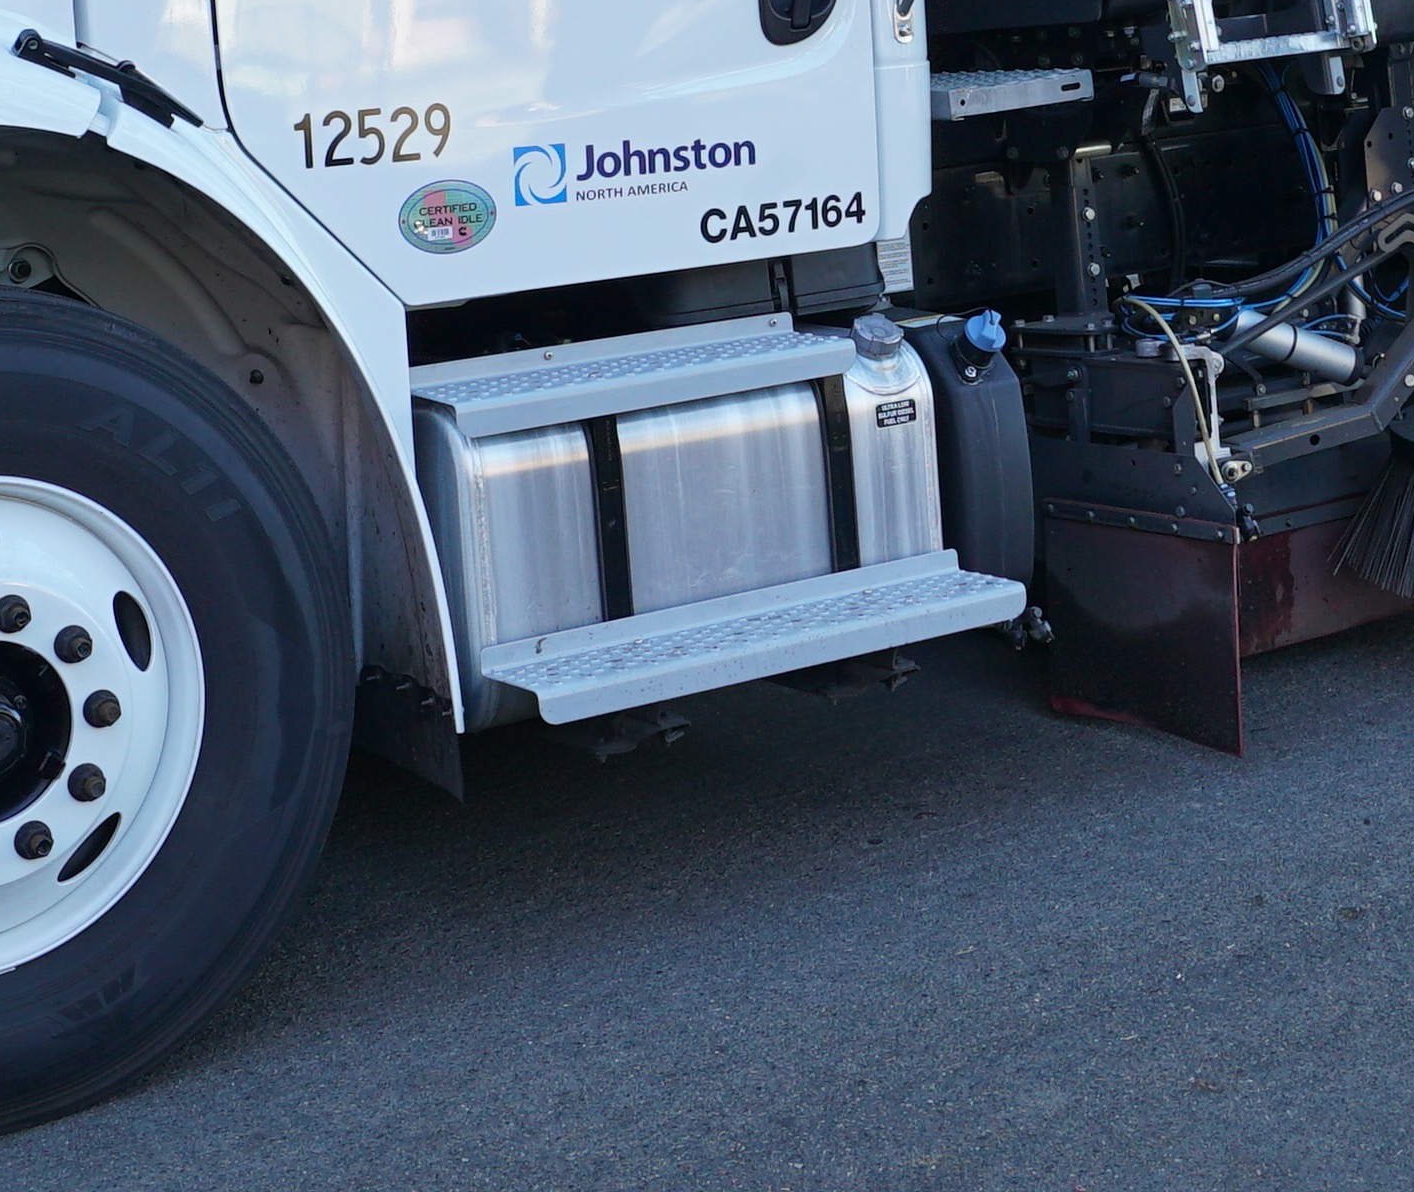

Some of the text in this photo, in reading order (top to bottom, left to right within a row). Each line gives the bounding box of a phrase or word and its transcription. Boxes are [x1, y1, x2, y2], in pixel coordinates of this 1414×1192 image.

[293, 102, 452, 169] 12529
[576, 137, 757, 182] Johnston
[418, 202, 478, 217] CERTIFIED
[575, 181, 689, 203] NORTH AMERICA
[413, 214, 484, 229] CLEAN IDLE
[699, 191, 867, 244] CA57164
[74, 401, 242, 523] AL11
